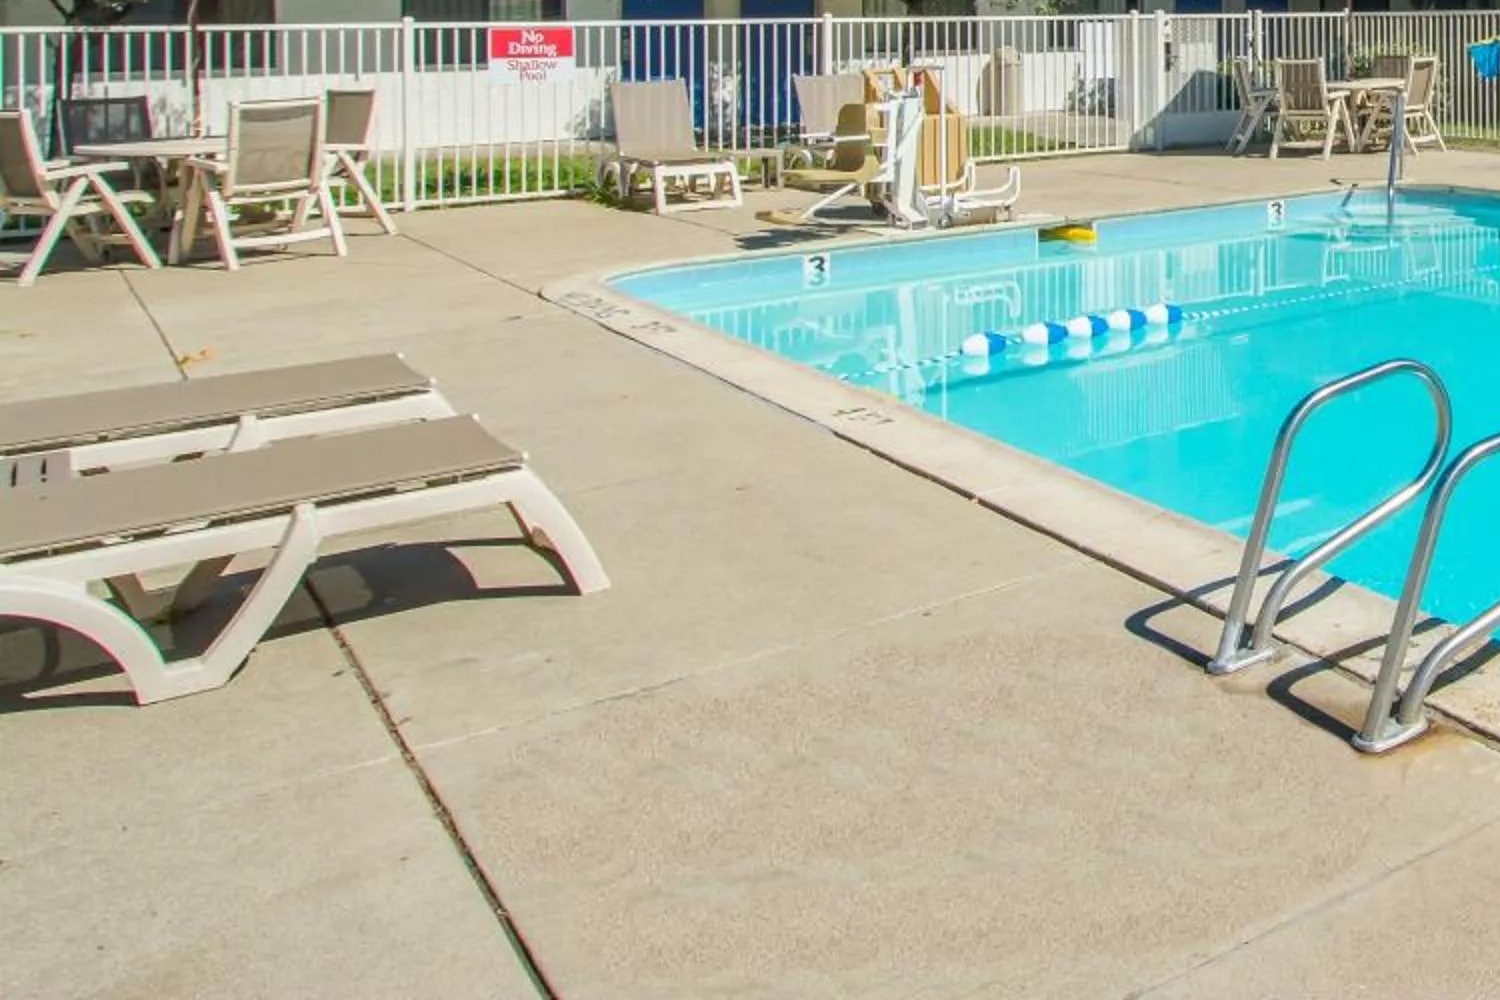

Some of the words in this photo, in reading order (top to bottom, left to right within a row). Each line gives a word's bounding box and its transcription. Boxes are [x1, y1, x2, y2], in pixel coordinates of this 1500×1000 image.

[521, 30, 544, 44] No
[507, 42, 557, 57] Diving
[507, 60, 557, 71] Shallow
